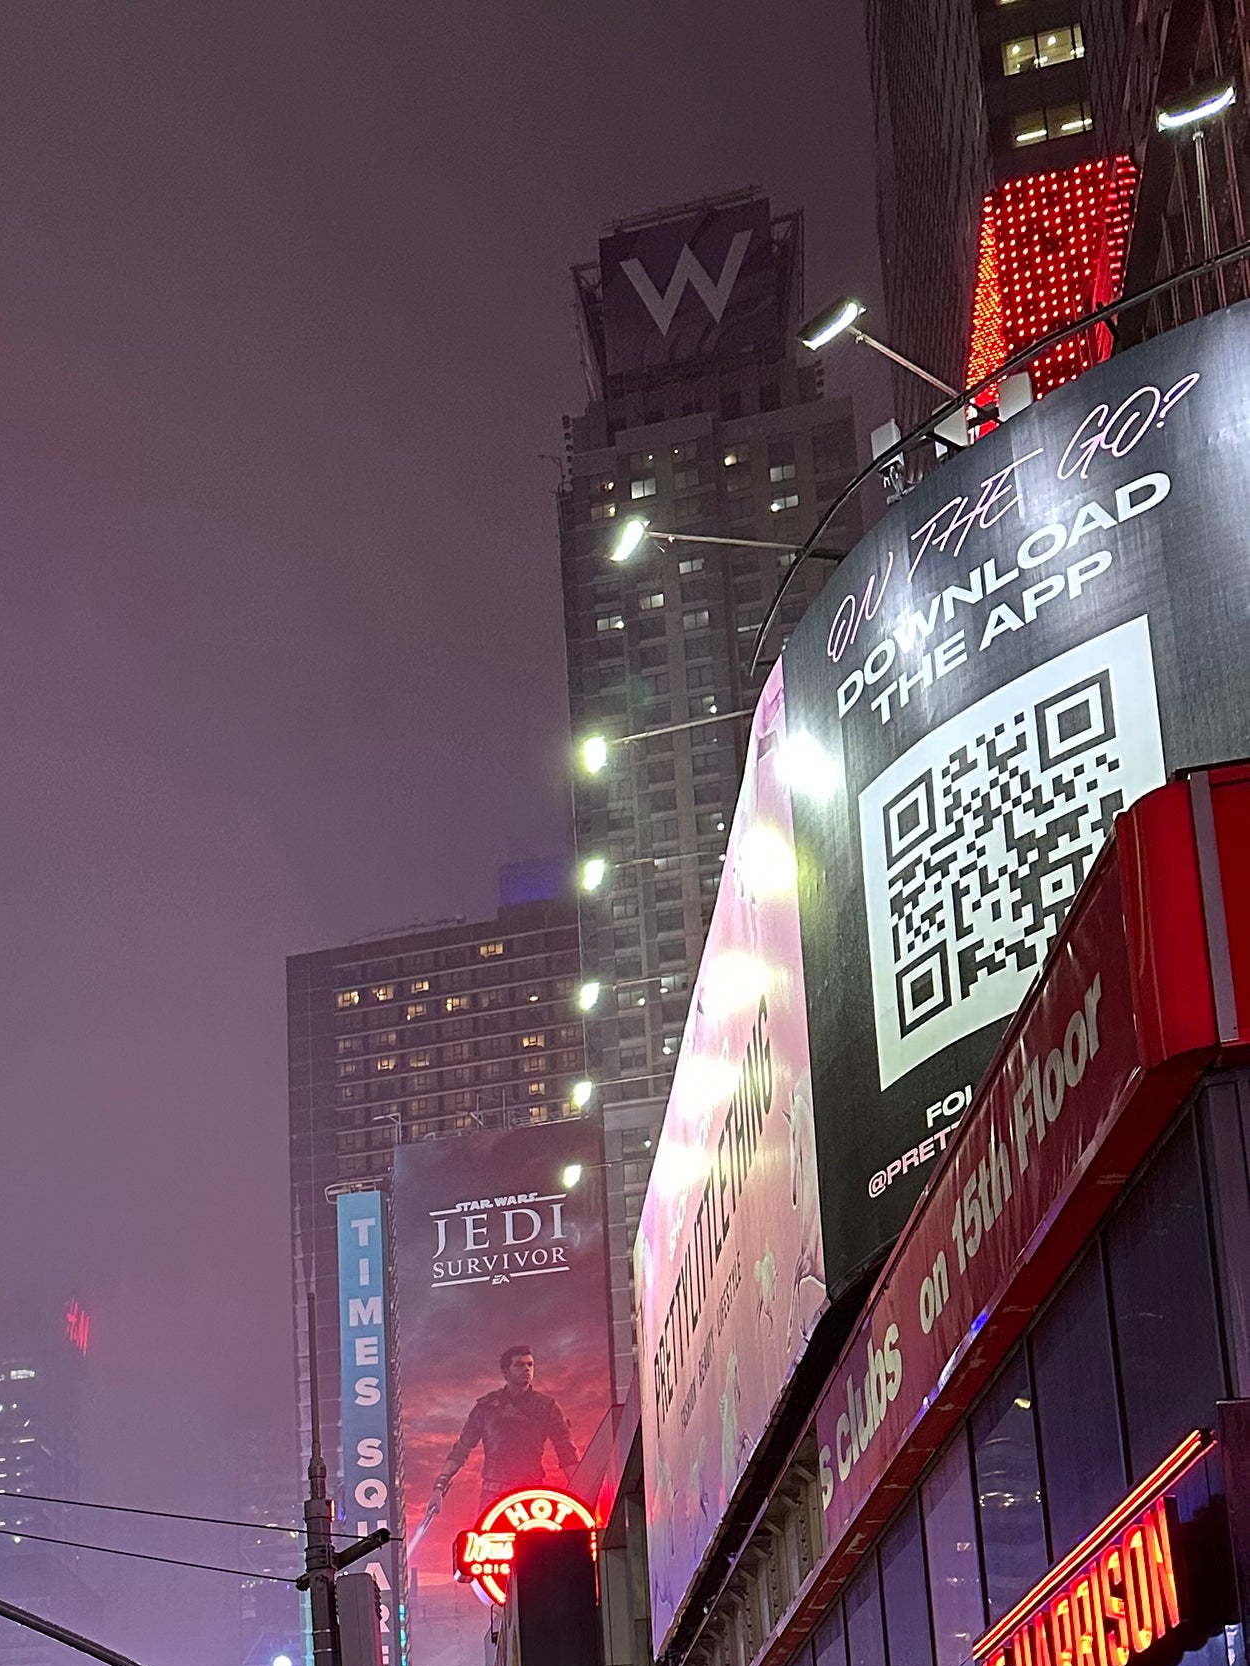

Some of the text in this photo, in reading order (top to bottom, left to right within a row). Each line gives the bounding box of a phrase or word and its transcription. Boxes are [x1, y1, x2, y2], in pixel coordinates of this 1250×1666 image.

[619, 229, 753, 336] W
[827, 372, 1200, 662] ON THE GO?
[837, 472, 1171, 719] DOWNLOAD
[871, 550, 1113, 725] THE APP
[432, 1203, 567, 1259] JEDI
[433, 1248, 567, 1279] SURVIVOR
[455, 1192, 539, 1212] STAR WARS
[653, 993, 773, 1440] PRETTYLITTLETHING
[836, 1323, 902, 1482] clubs
[919, 1250, 950, 1335] on
[952, 1142, 1012, 1276] 15th
[1014, 971, 1102, 1177] Floor
[349, 1218, 383, 1406] TIMES
[492, 1275, 510, 1285] EA
[505, 1498, 573, 1527] HOT
